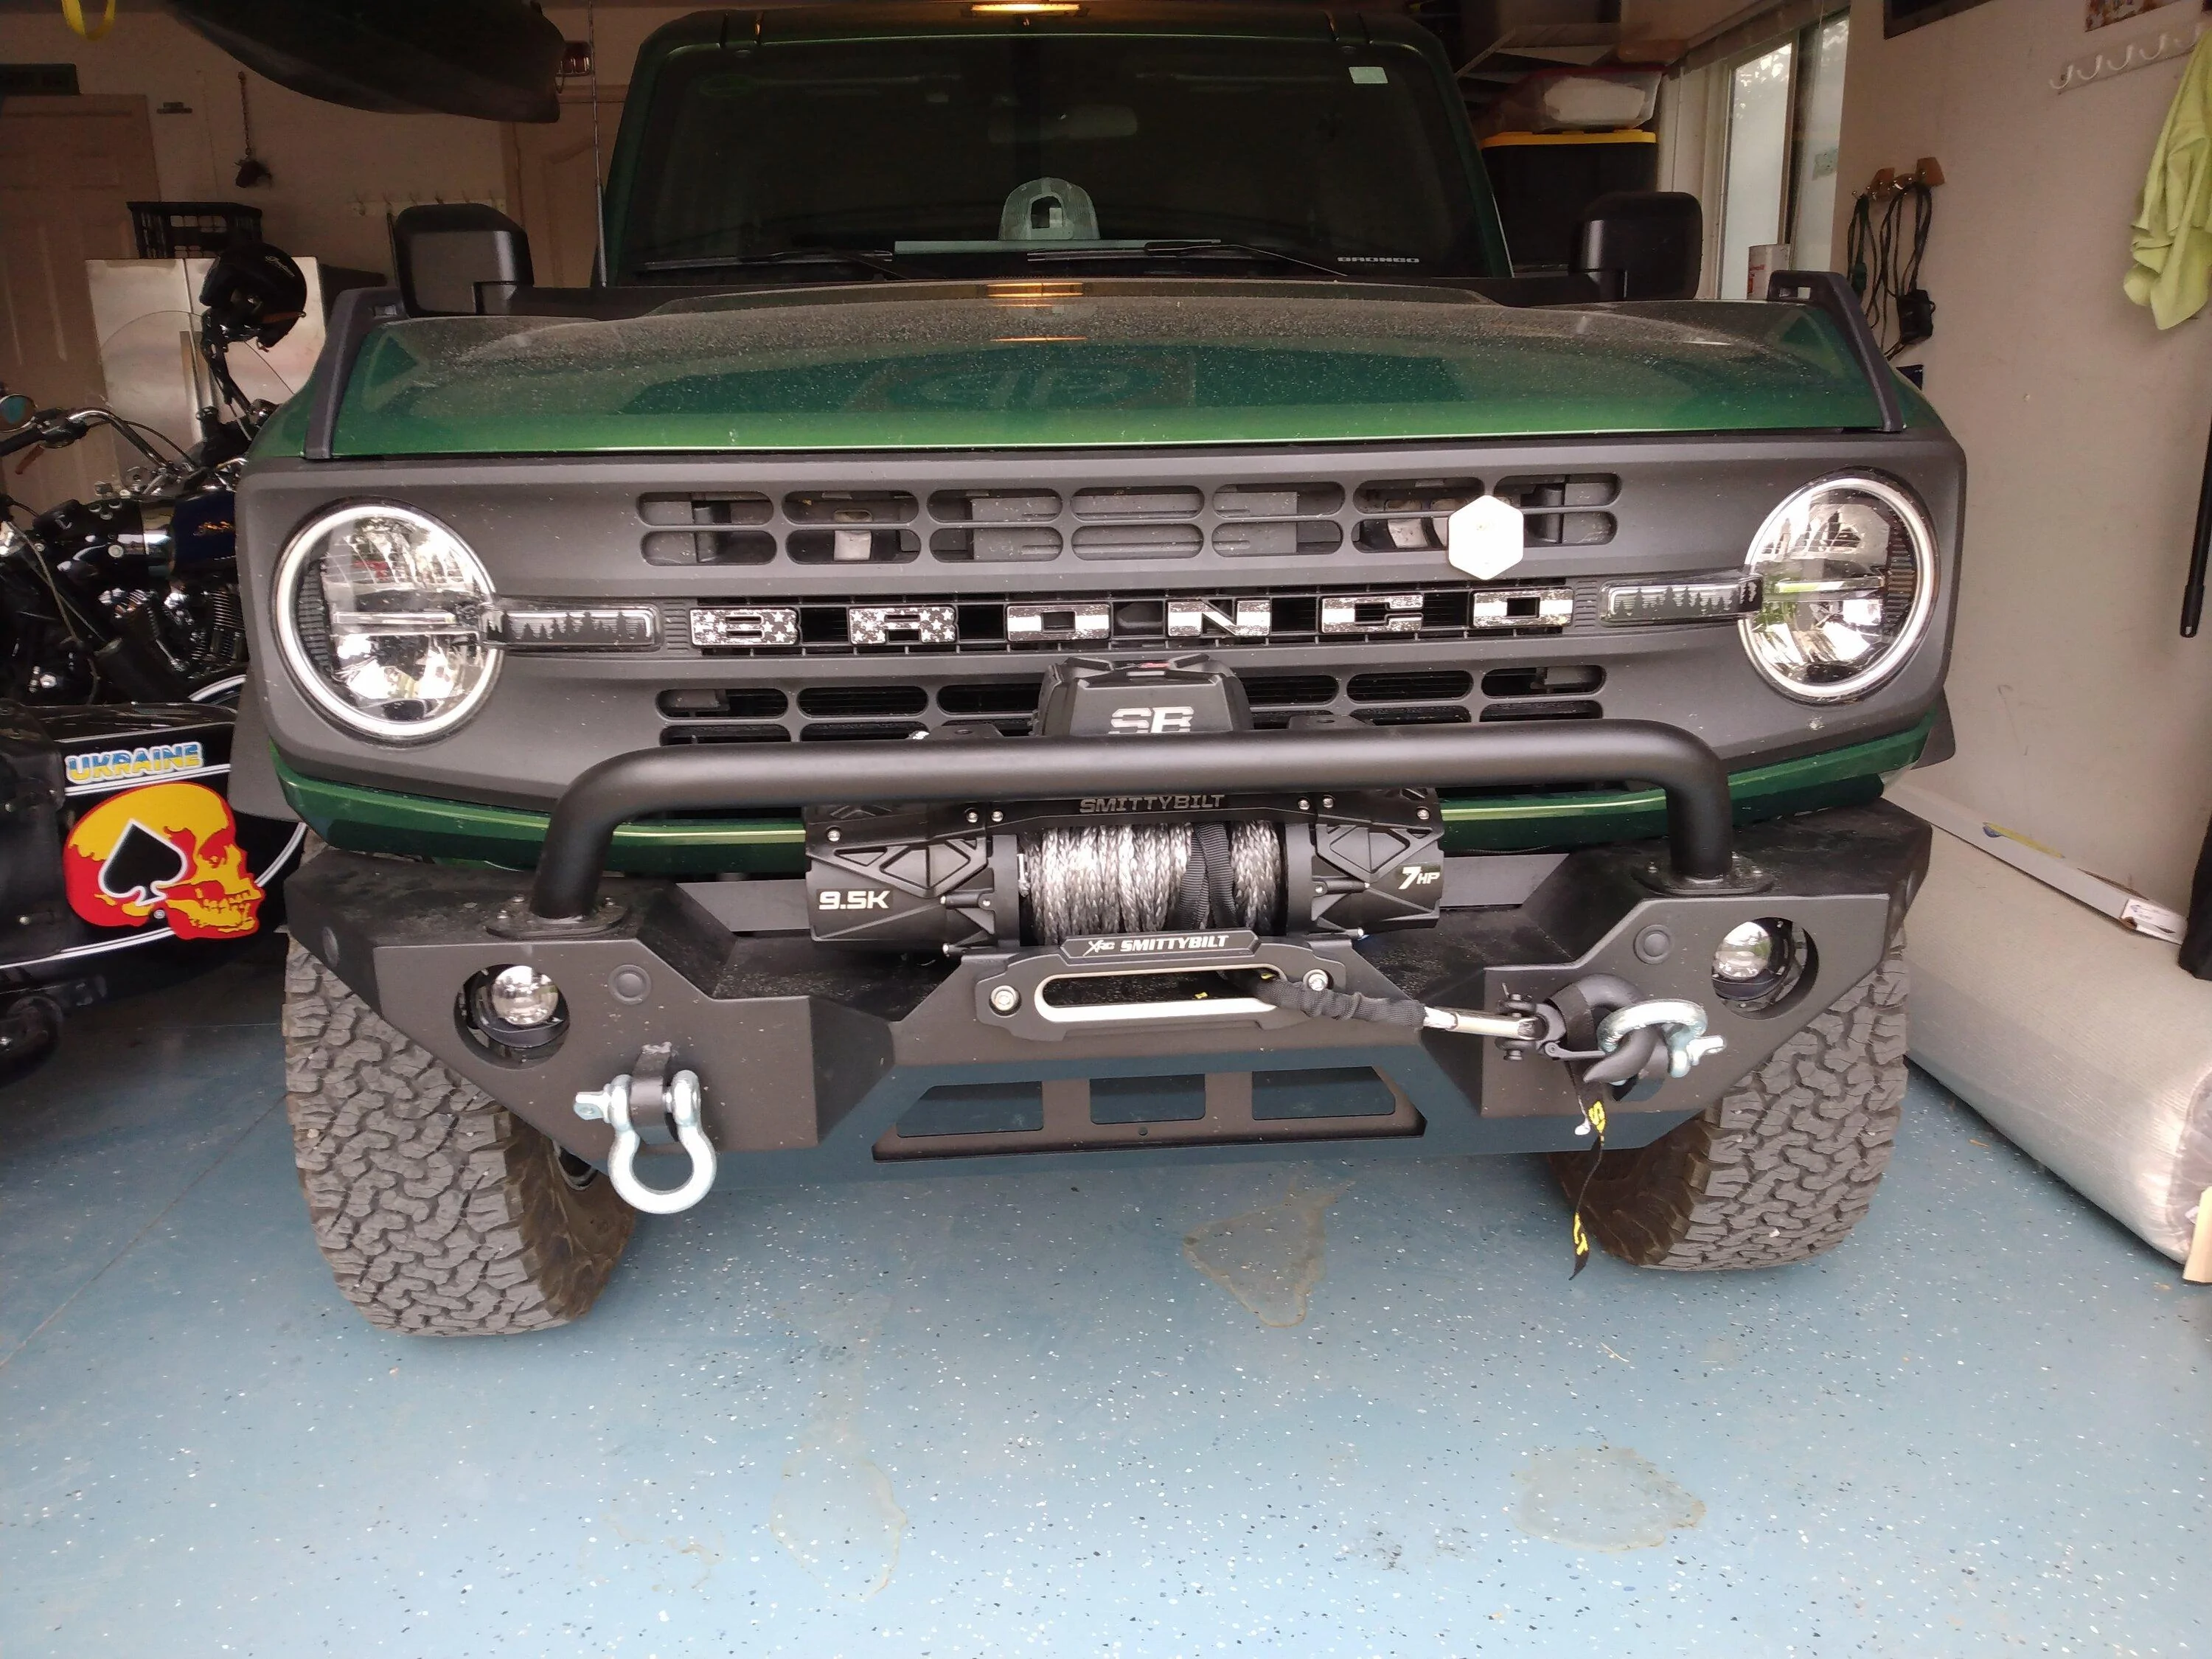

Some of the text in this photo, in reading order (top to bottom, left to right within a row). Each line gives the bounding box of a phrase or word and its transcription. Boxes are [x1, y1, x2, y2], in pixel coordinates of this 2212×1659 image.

[689, 588, 1573, 647] BRONCO
[66, 742, 203, 783] UKRAINE
[1079, 794, 1225, 813] SMITTYBILT
[818, 890, 891, 910] 9.5K
[1120, 934, 1229, 952] SMITTYBILT
